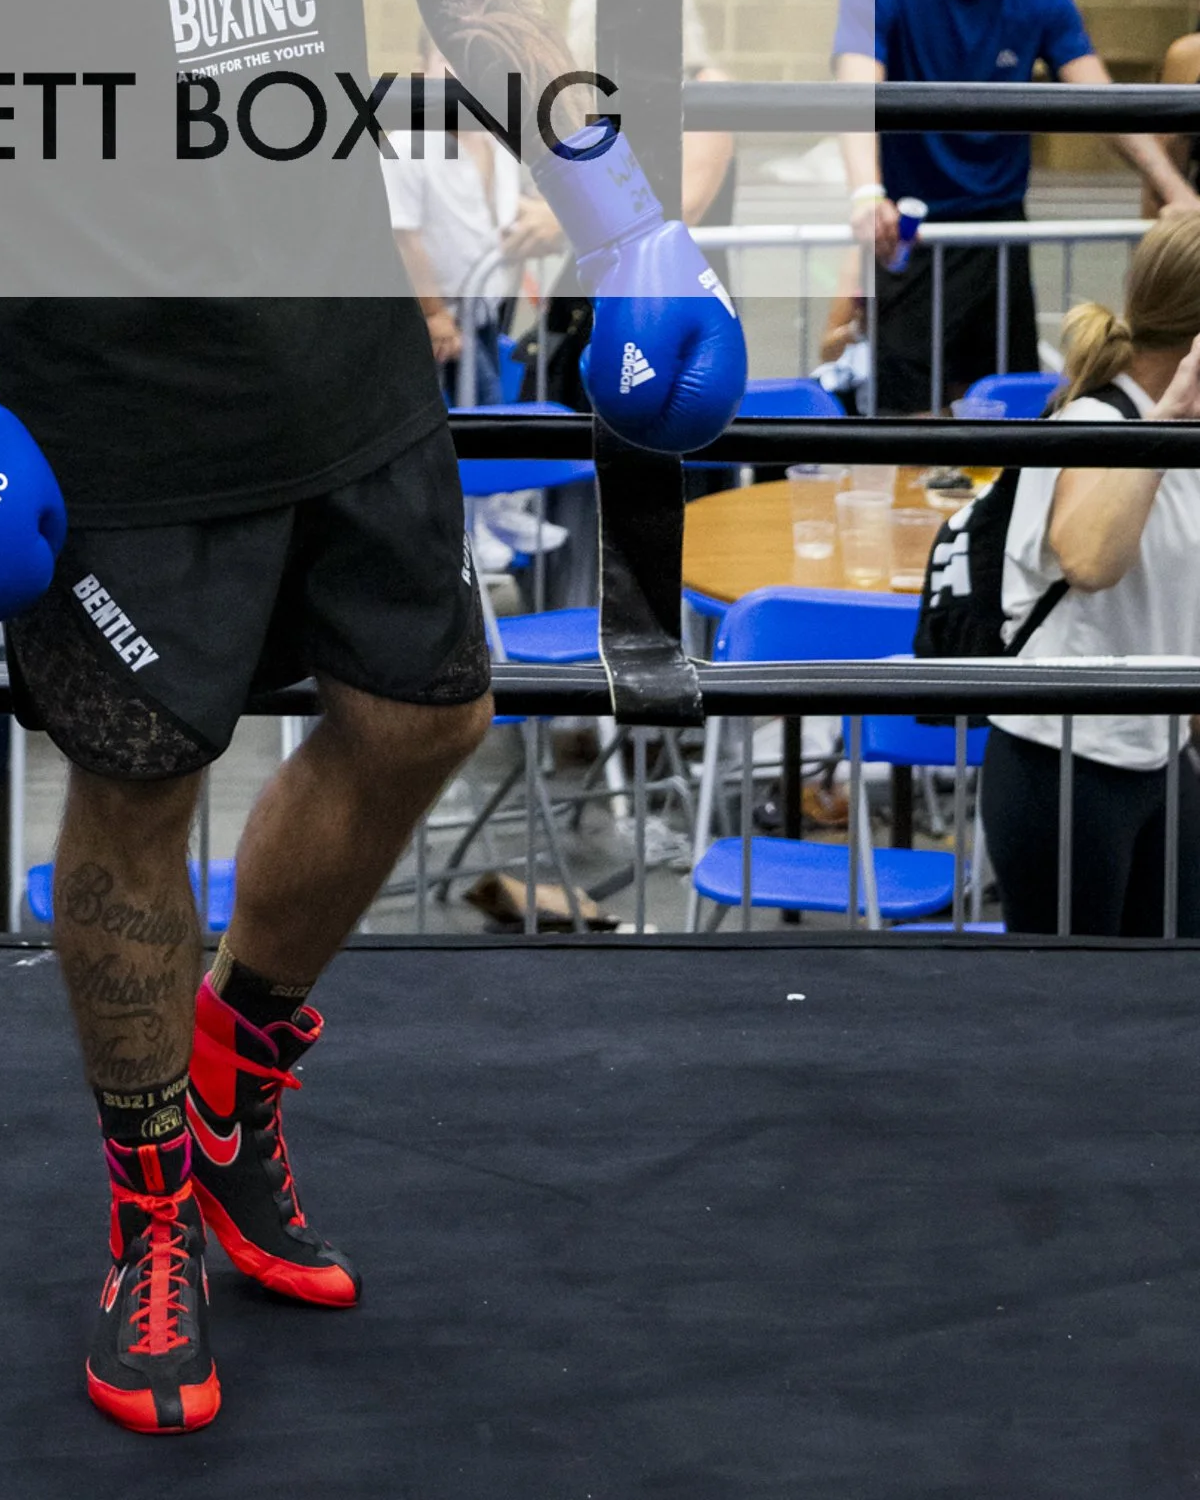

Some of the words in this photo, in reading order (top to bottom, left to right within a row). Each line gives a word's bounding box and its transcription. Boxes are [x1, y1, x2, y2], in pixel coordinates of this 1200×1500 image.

[177, 70, 189, 84] A
[191, 63, 219, 81] PATH
[220, 58, 242, 76] FOR
[244, 51, 272, 69] THE
[274, 41, 325, 61] YOUTH
[618, 341, 637, 395] adidas
[71, 573, 160, 673] BENTLEY
[103, 1091, 155, 1109] SUZI
